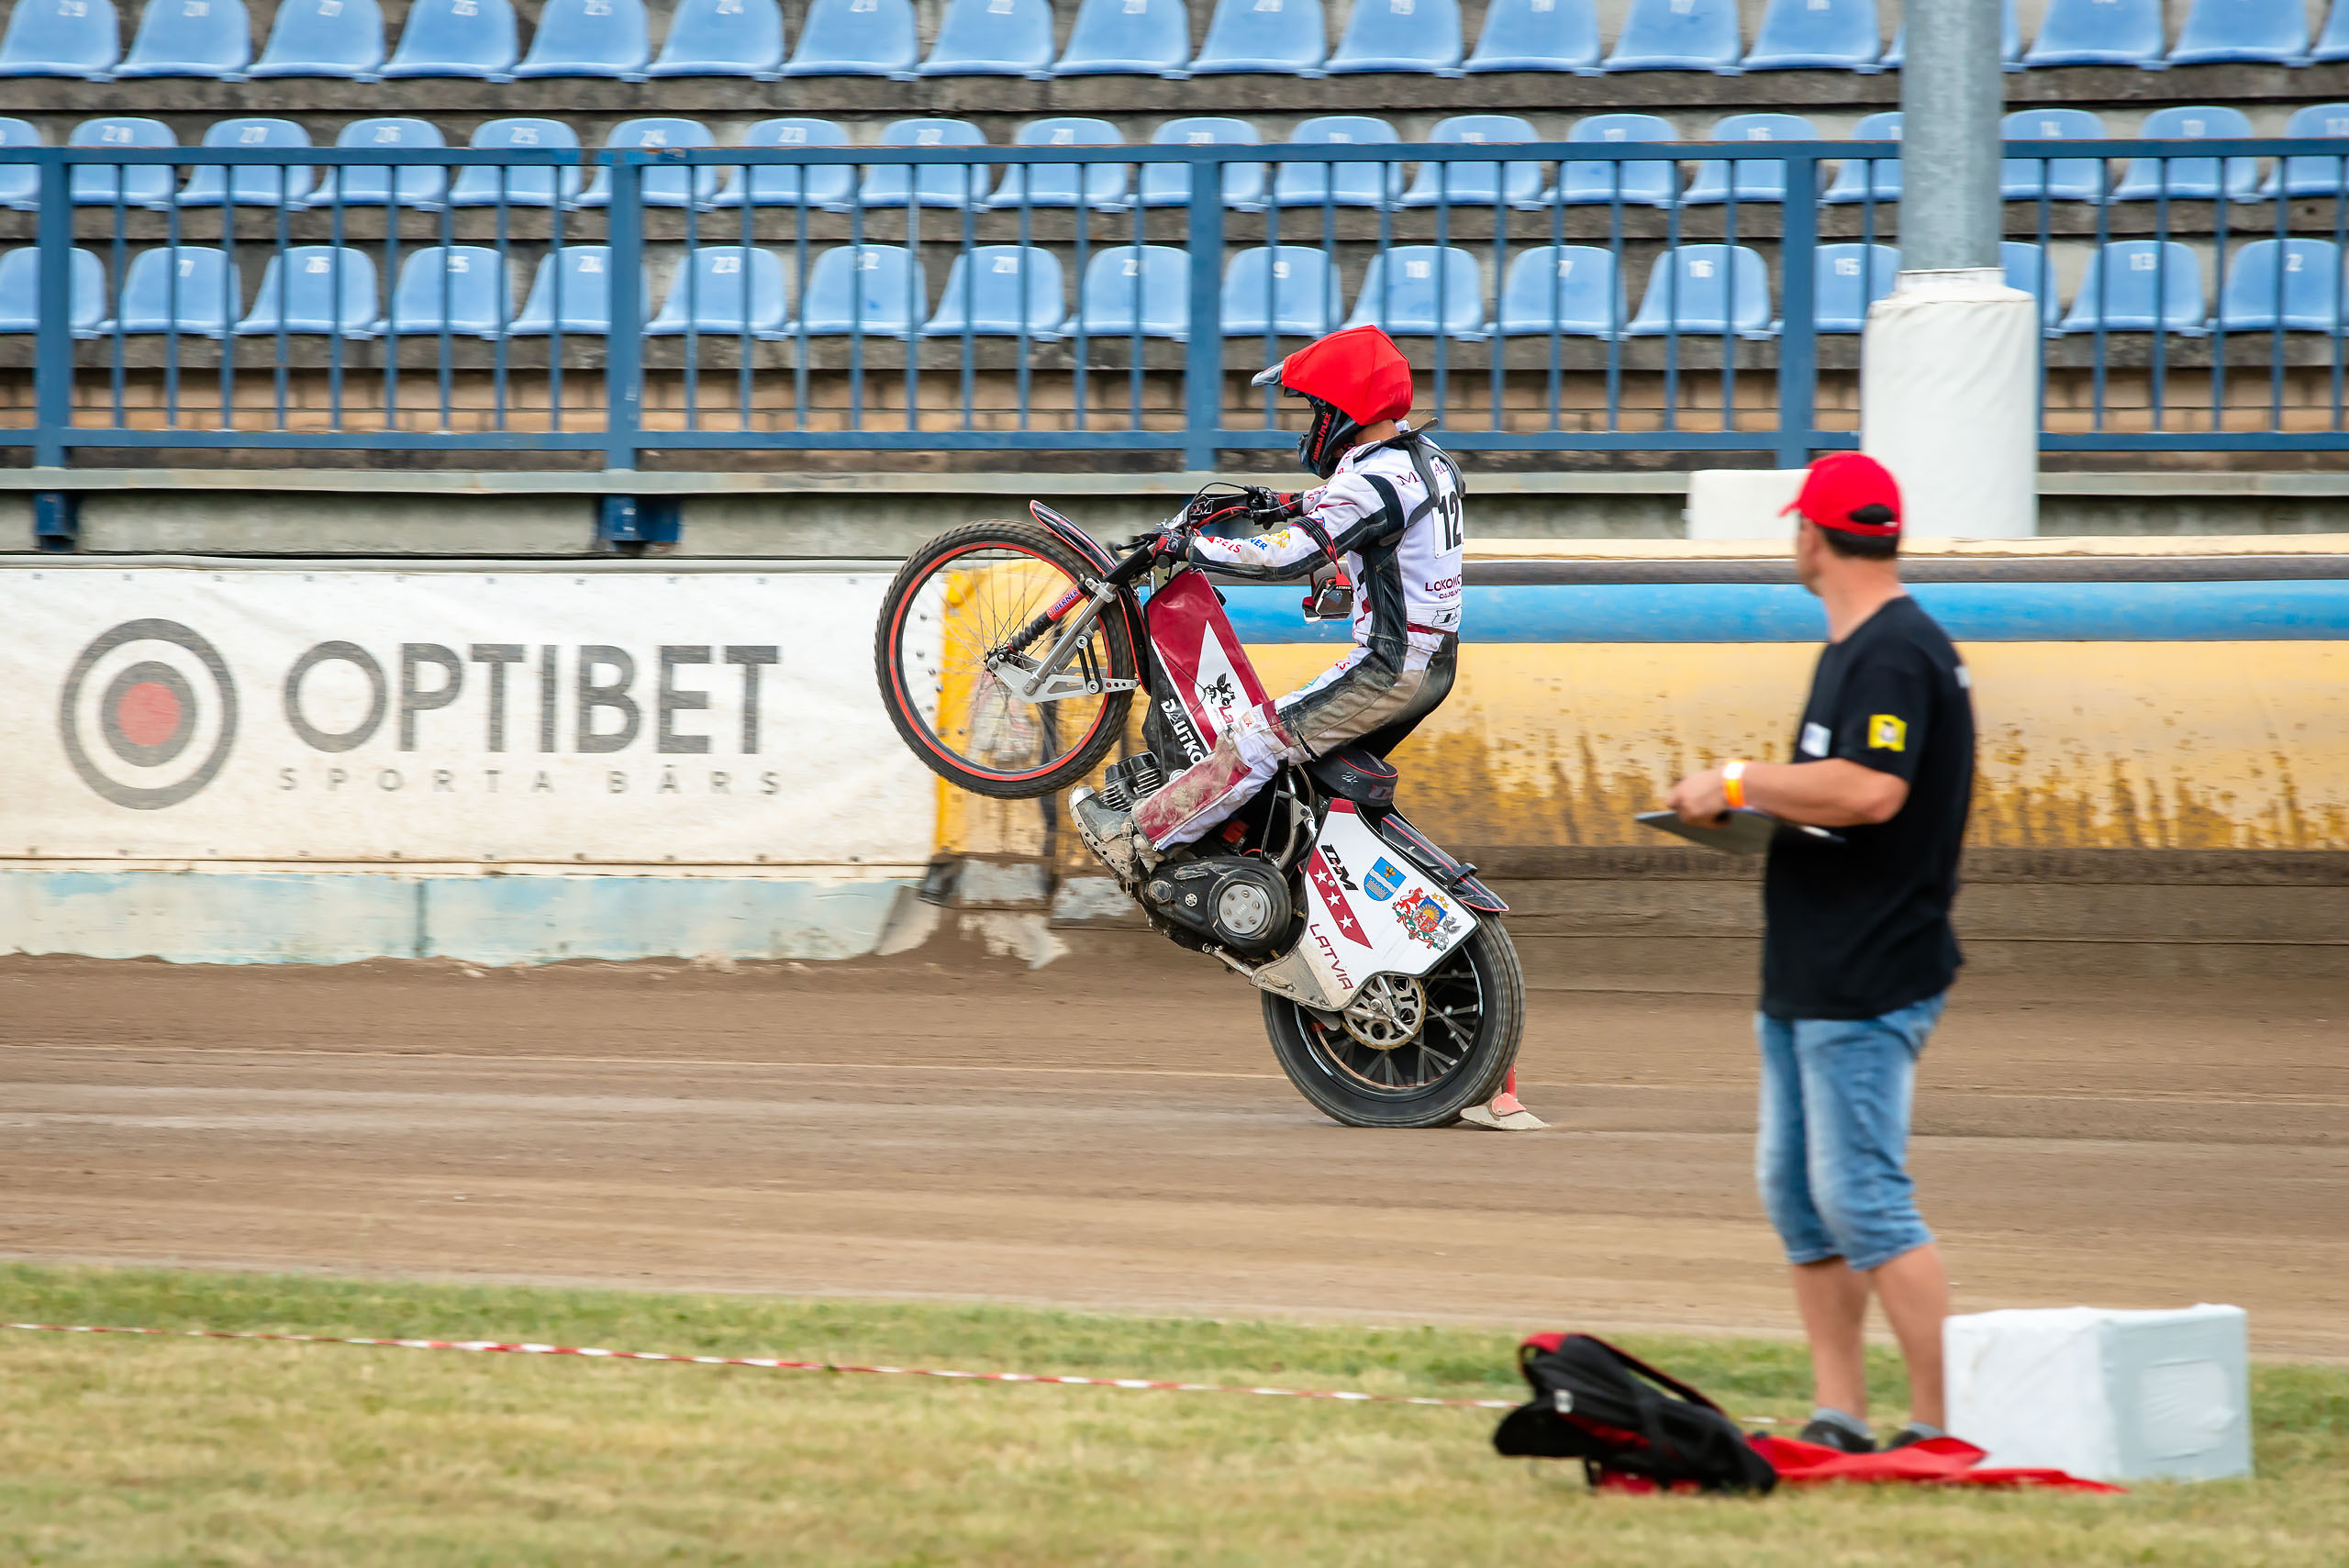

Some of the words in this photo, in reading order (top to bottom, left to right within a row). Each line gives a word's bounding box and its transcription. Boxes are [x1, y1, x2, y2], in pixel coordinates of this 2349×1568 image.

[1438, 490, 1462, 550] 12
[284, 640, 781, 754] OPTIBET
[279, 767, 554, 794] SPORTA
[607, 763, 781, 795] BĀRS
[1308, 923, 1354, 990] LATVIA
